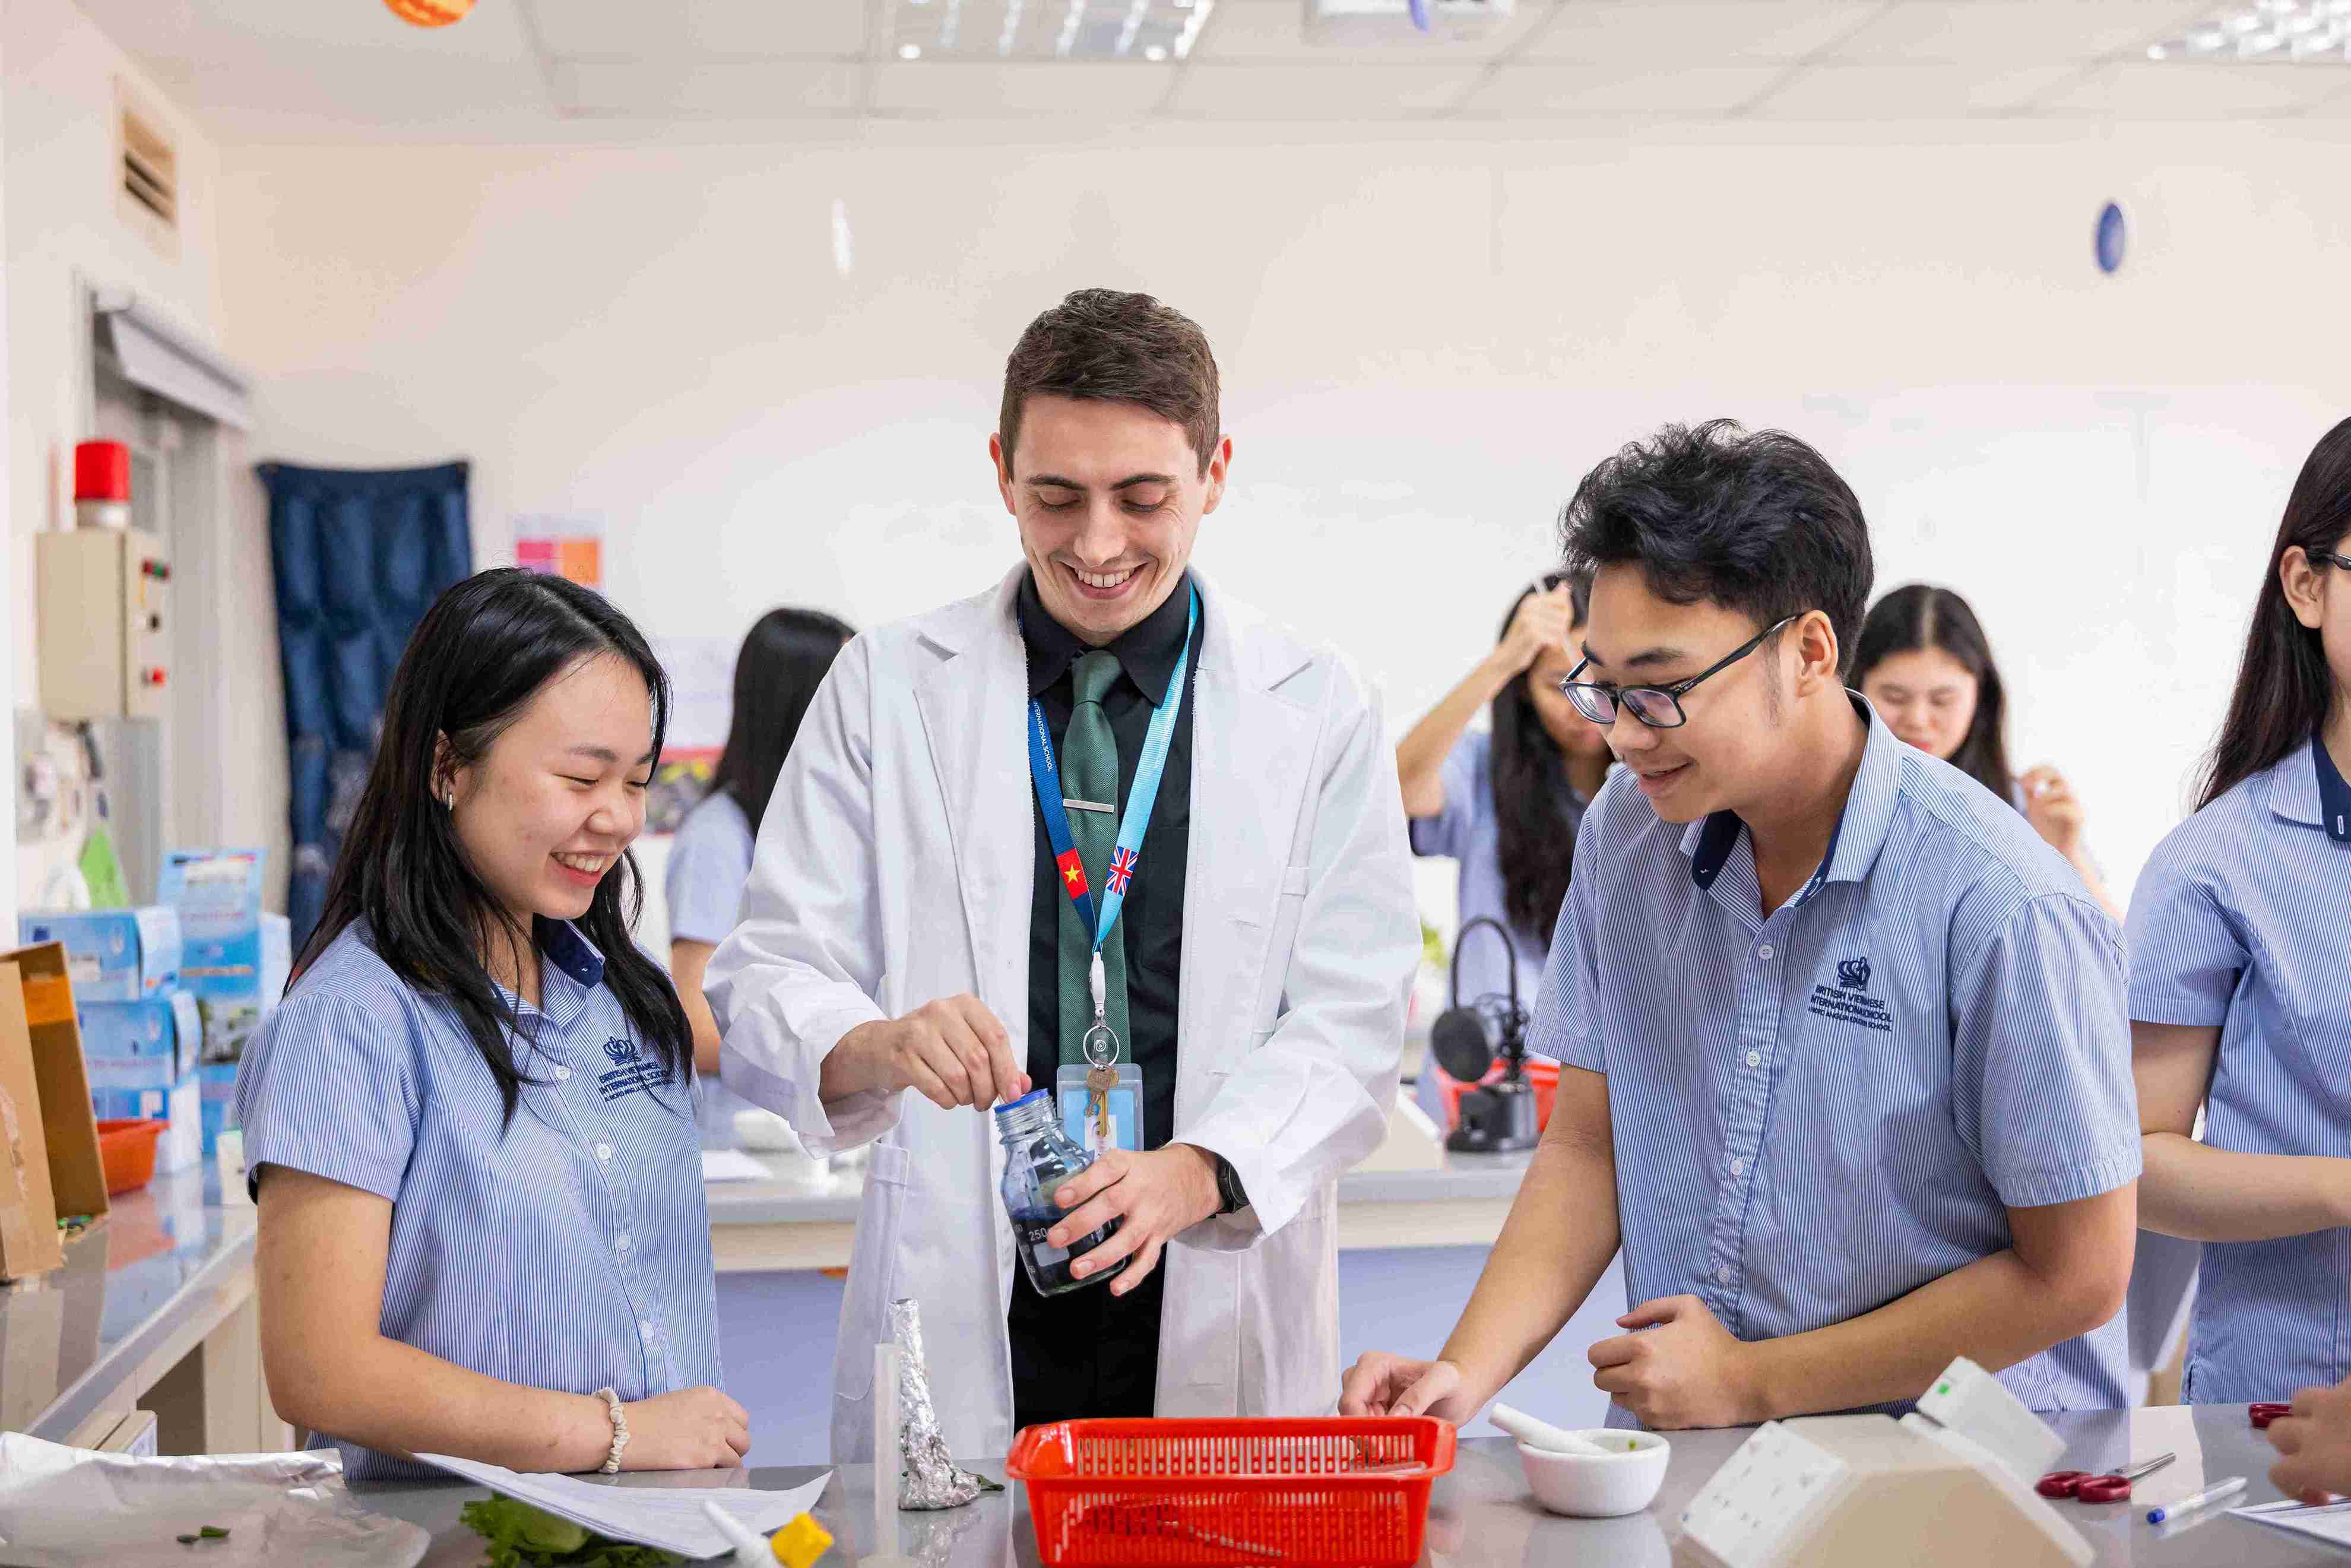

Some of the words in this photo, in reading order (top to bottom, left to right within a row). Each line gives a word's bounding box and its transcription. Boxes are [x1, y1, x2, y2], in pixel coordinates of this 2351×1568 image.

[1033, 701, 1047, 746] INTERNATIONAL
[1043, 746, 1054, 772] SCHOOL
[1815, 985, 1846, 999] BRITISH
[598, 1068, 626, 1084] BRITISH
